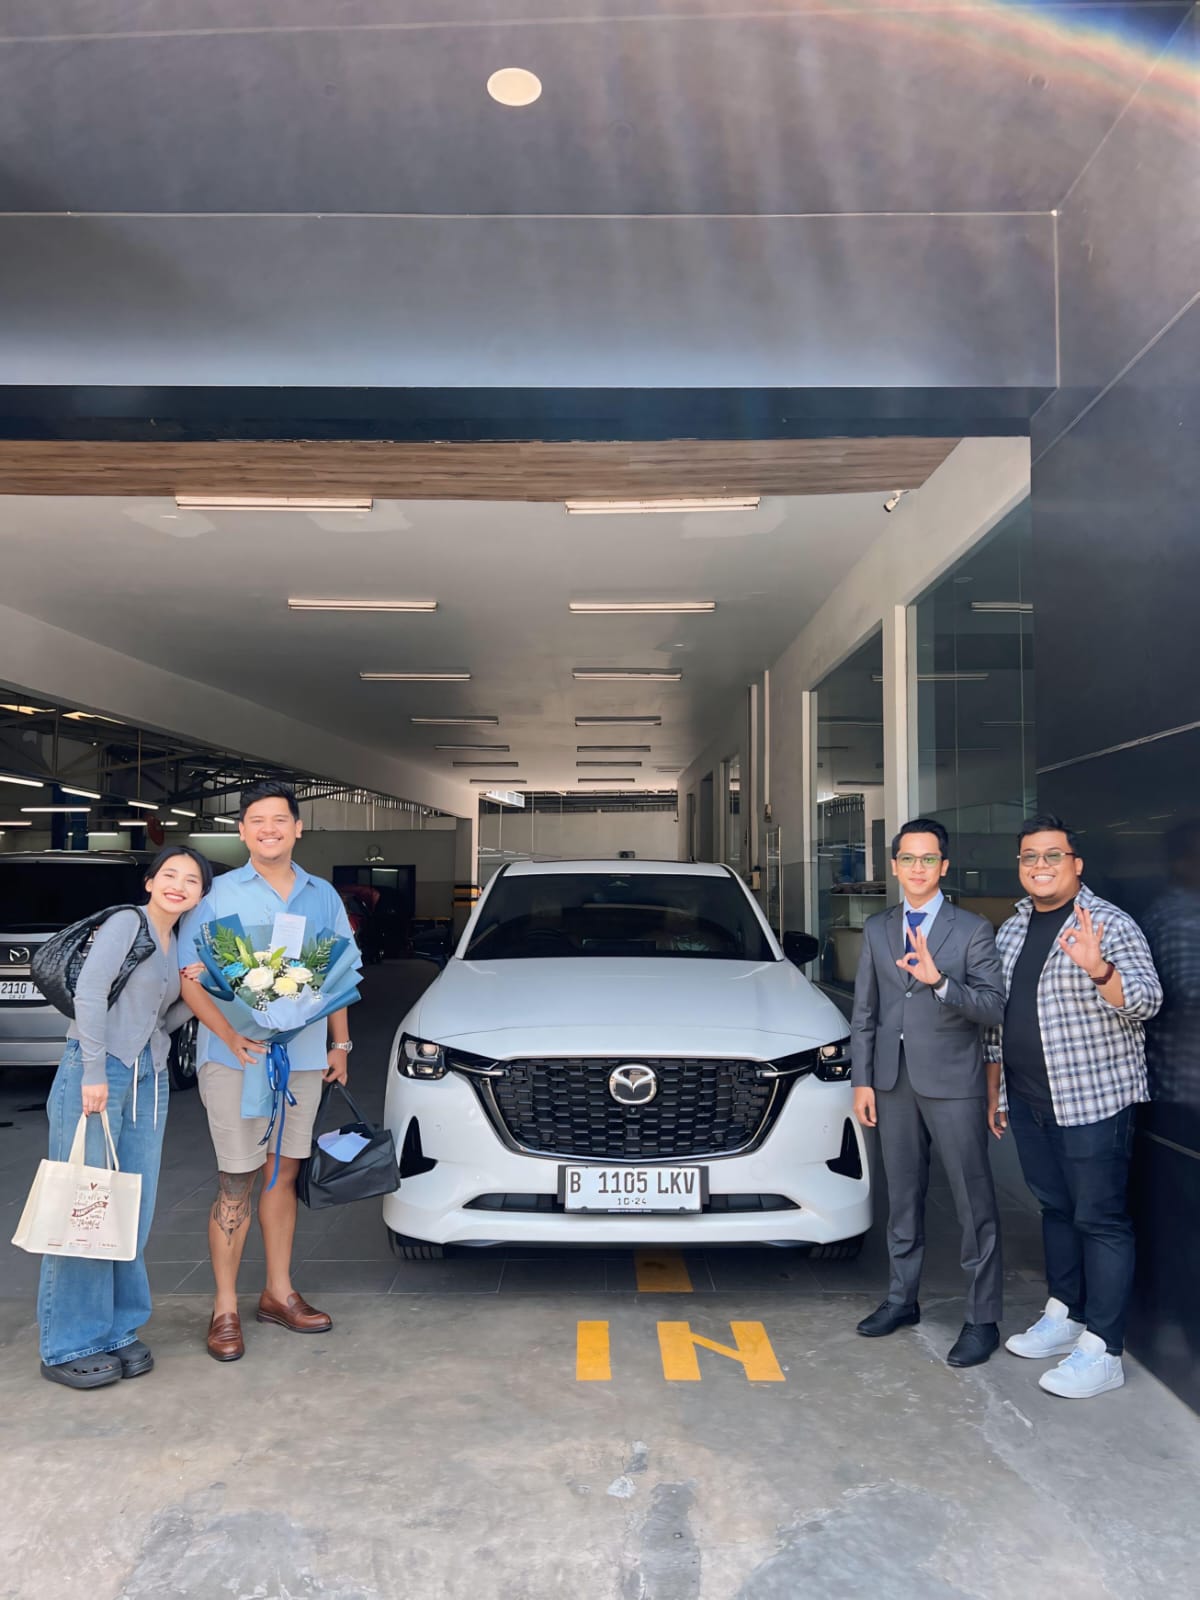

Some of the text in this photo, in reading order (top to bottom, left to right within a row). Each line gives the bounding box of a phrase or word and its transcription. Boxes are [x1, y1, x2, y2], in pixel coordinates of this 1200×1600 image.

[1, 983, 27, 994] 2110
[569, 1171, 696, 1194] B 1105 LKV
[576, 1320, 786, 1382] IN
